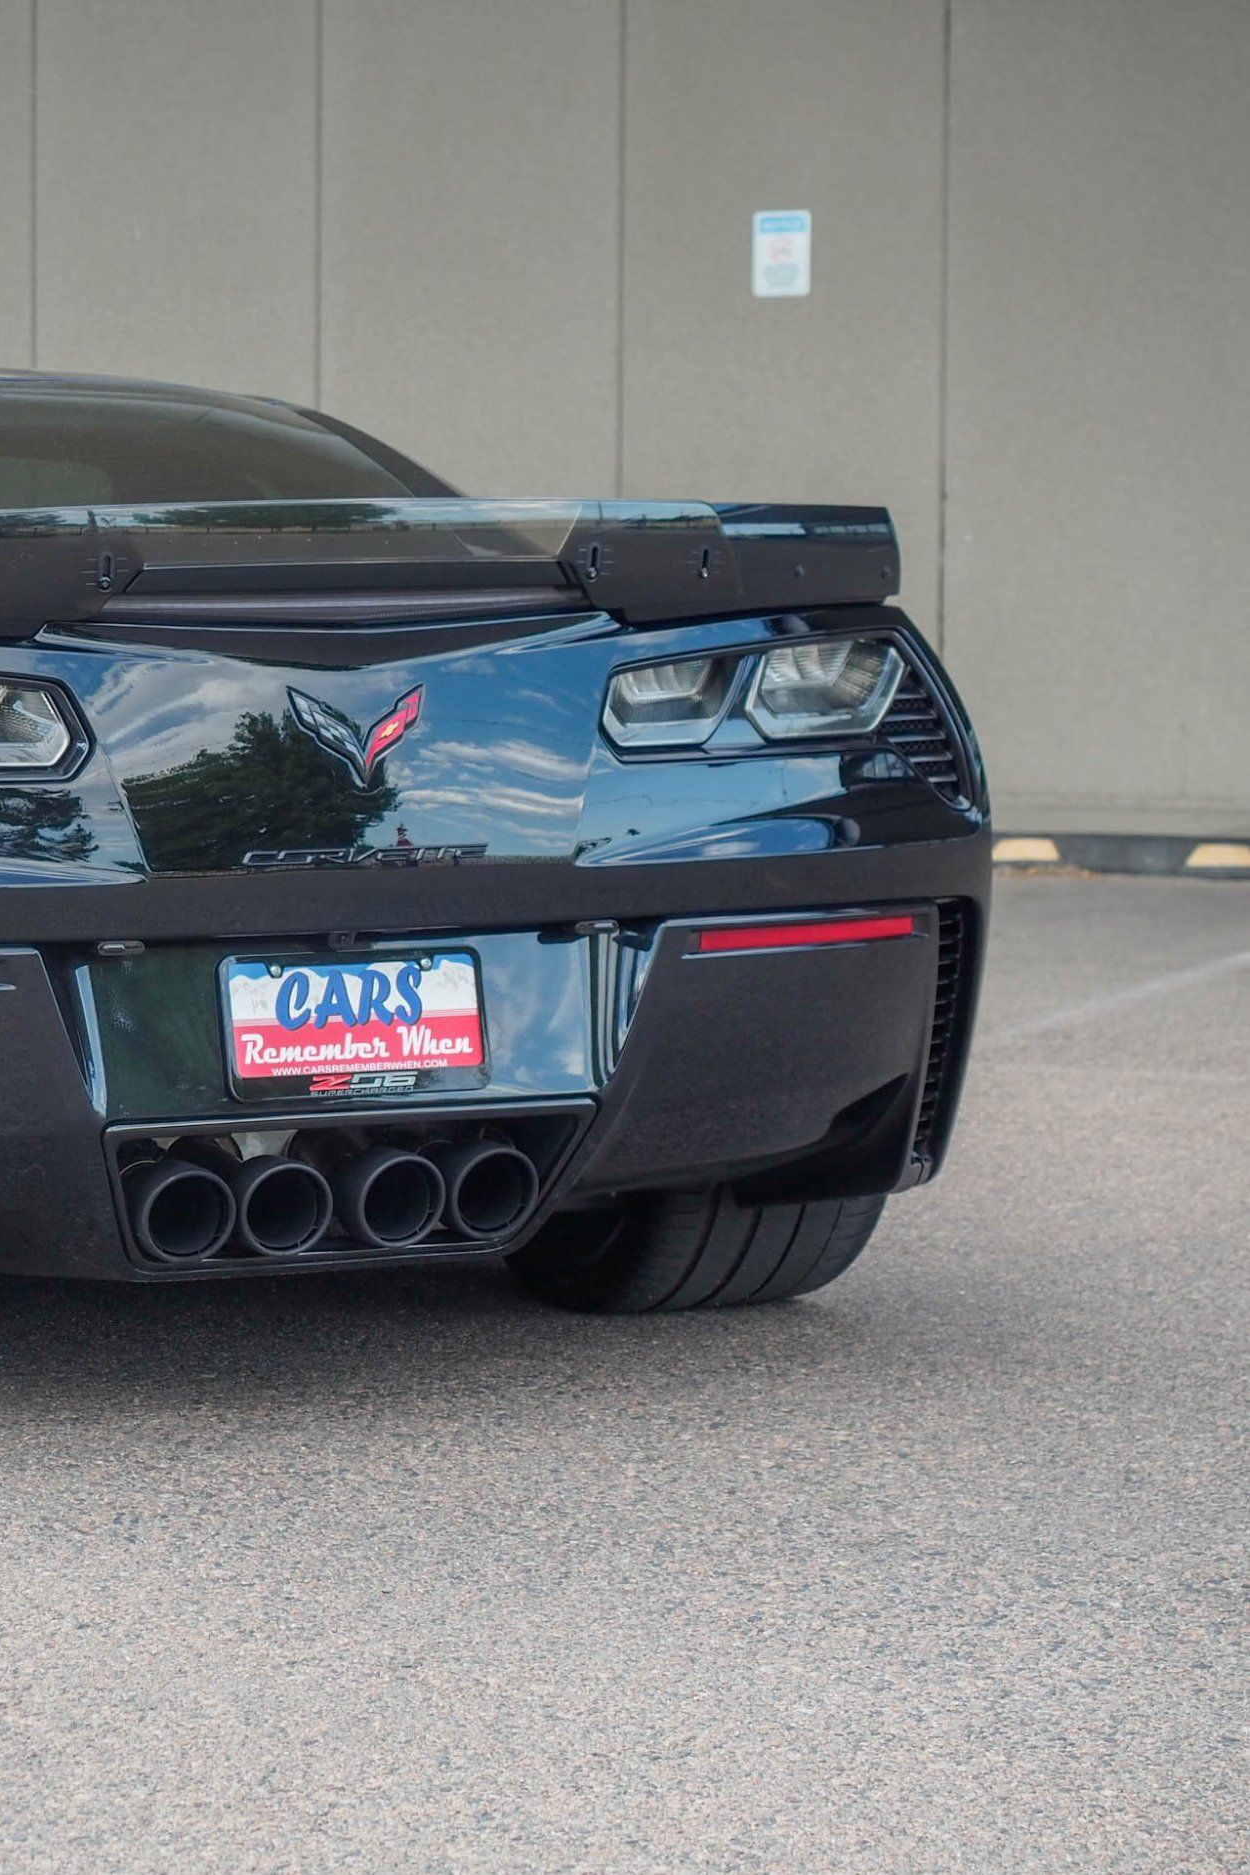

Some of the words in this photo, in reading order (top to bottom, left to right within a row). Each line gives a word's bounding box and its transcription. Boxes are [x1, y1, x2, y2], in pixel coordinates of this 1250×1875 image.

[275, 965, 423, 1030] CARS
[241, 1033, 390, 1065] Remember
[396, 1025, 474, 1056] When
[271, 1059, 448, 1077] WWW.CARSREMEMBERWHEN.COM
[309, 1071, 419, 1091] Z06
[310, 1086, 414, 1097] SUPERCHARGED
